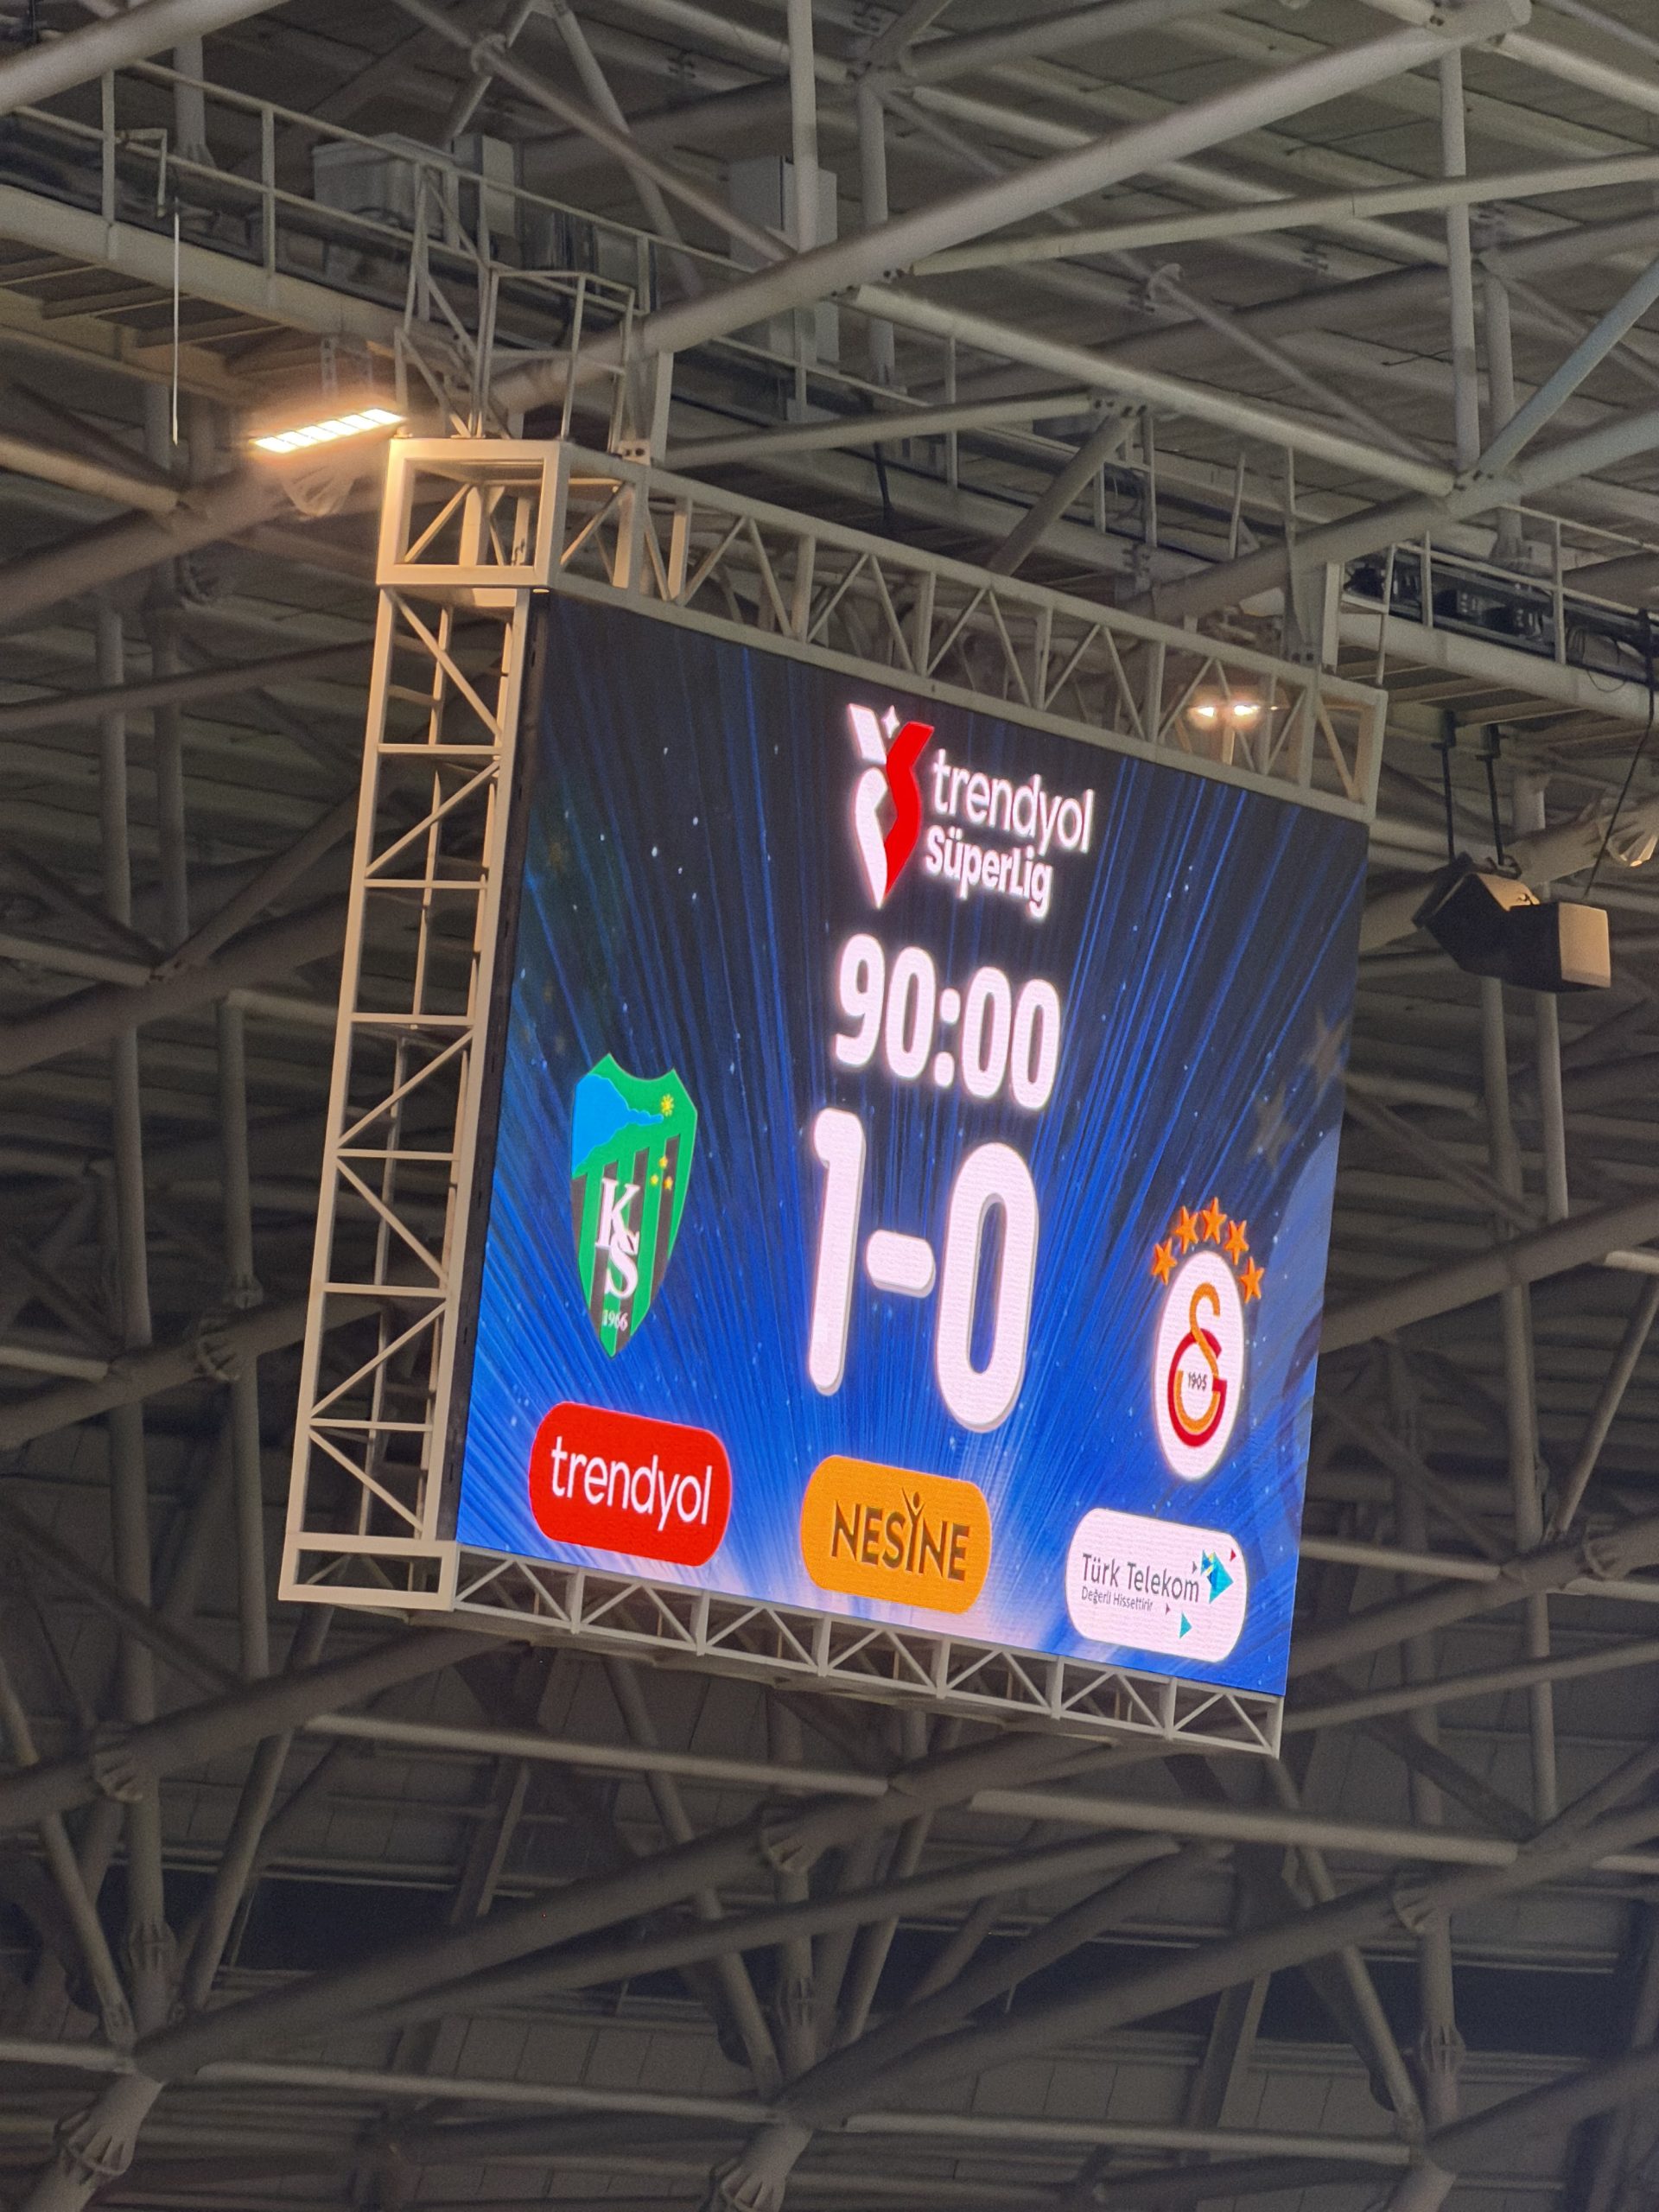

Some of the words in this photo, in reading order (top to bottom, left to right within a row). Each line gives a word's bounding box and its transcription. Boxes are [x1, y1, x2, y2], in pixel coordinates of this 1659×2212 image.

[933, 748, 1094, 855] trendyol
[835, 933, 1060, 1109] 90:00
[1187, 1371, 1207, 1390] 1905
[551, 1436, 712, 1531] trendyol
[1081, 1585, 1111, 1605] Değerli
[1083, 1553, 1120, 1588] Türk
[1127, 1561, 1199, 1603] Telekom
